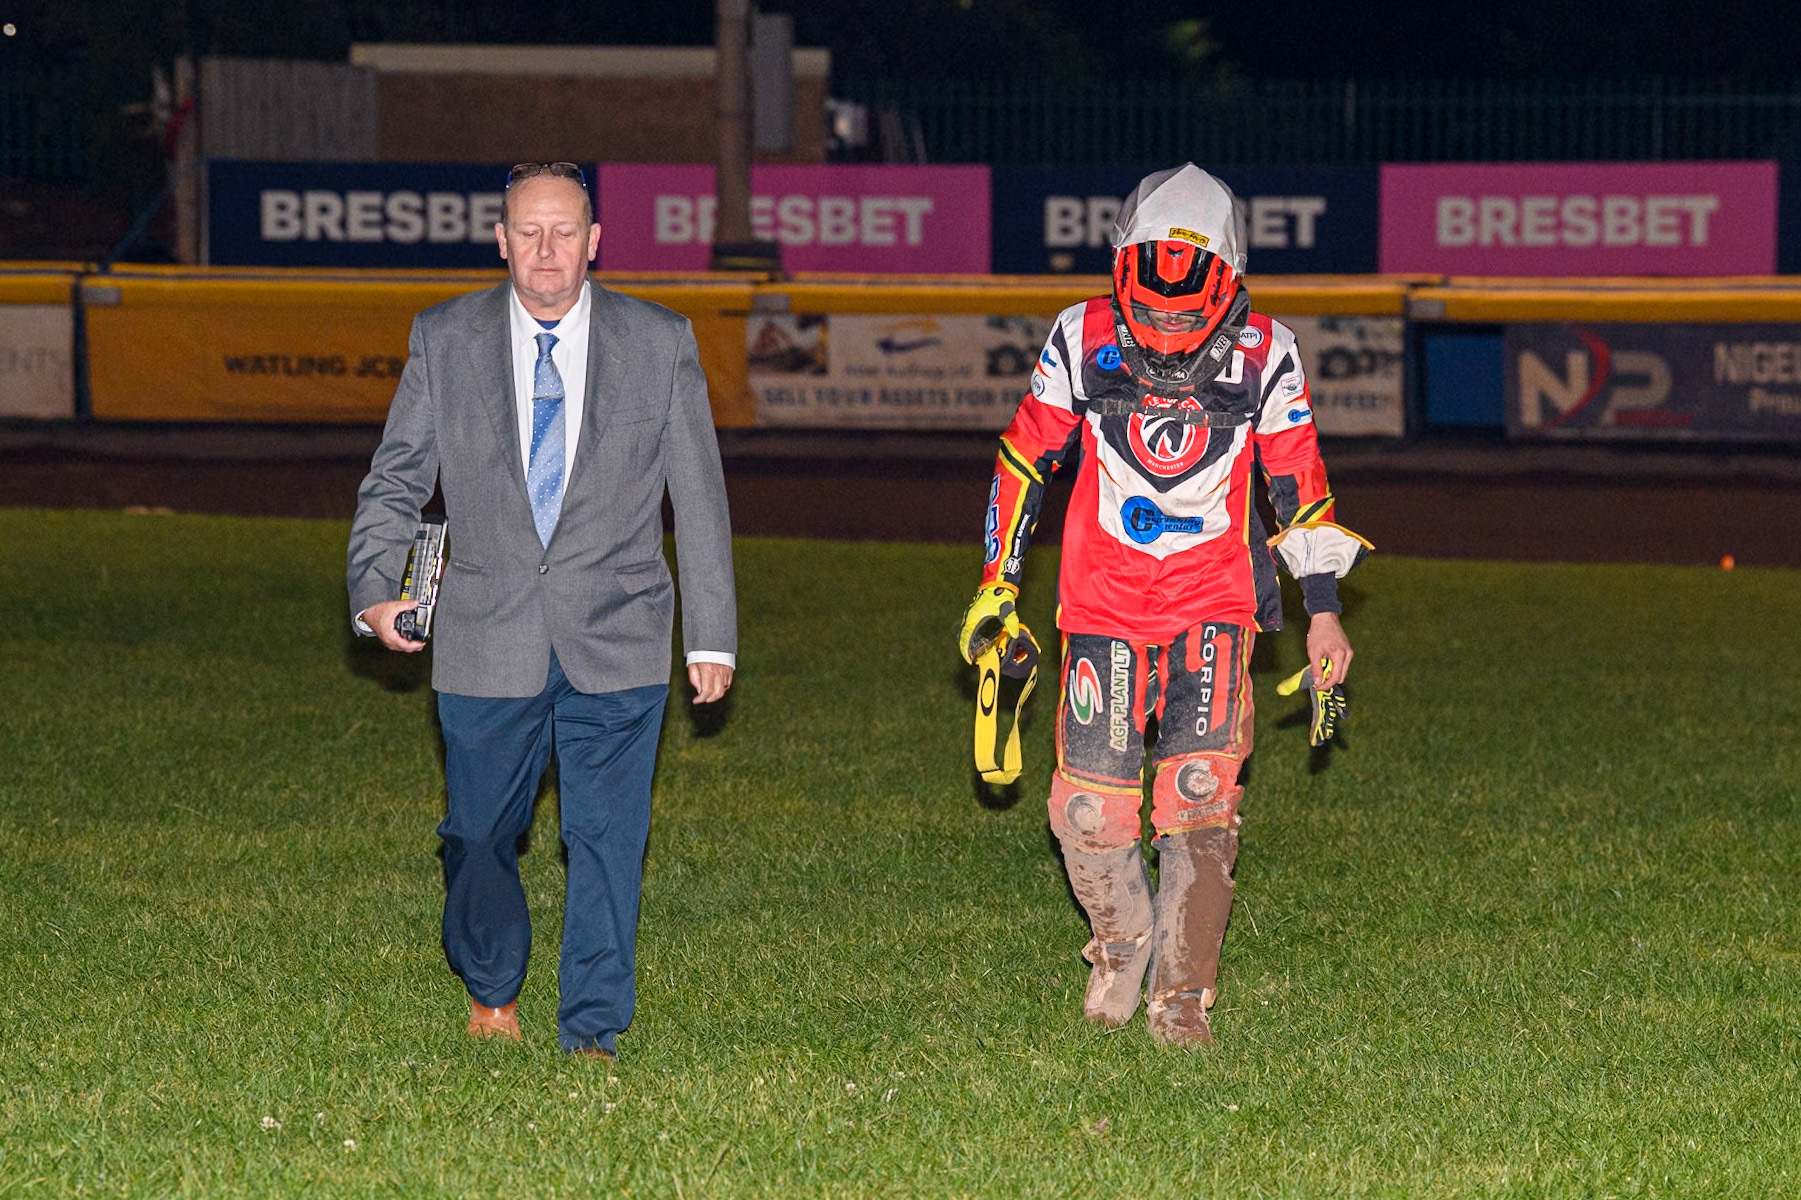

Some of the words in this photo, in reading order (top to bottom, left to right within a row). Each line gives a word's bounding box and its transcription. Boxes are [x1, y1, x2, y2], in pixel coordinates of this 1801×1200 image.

[261, 191, 505, 242] BRESBE
[1044, 196, 1327, 249] BRET
[1437, 196, 1719, 247] BRESBET
[223, 353, 346, 377] WATLING
[1147, 459, 1184, 470] MANCHESTER
[1113, 668, 1126, 715] PLANT
